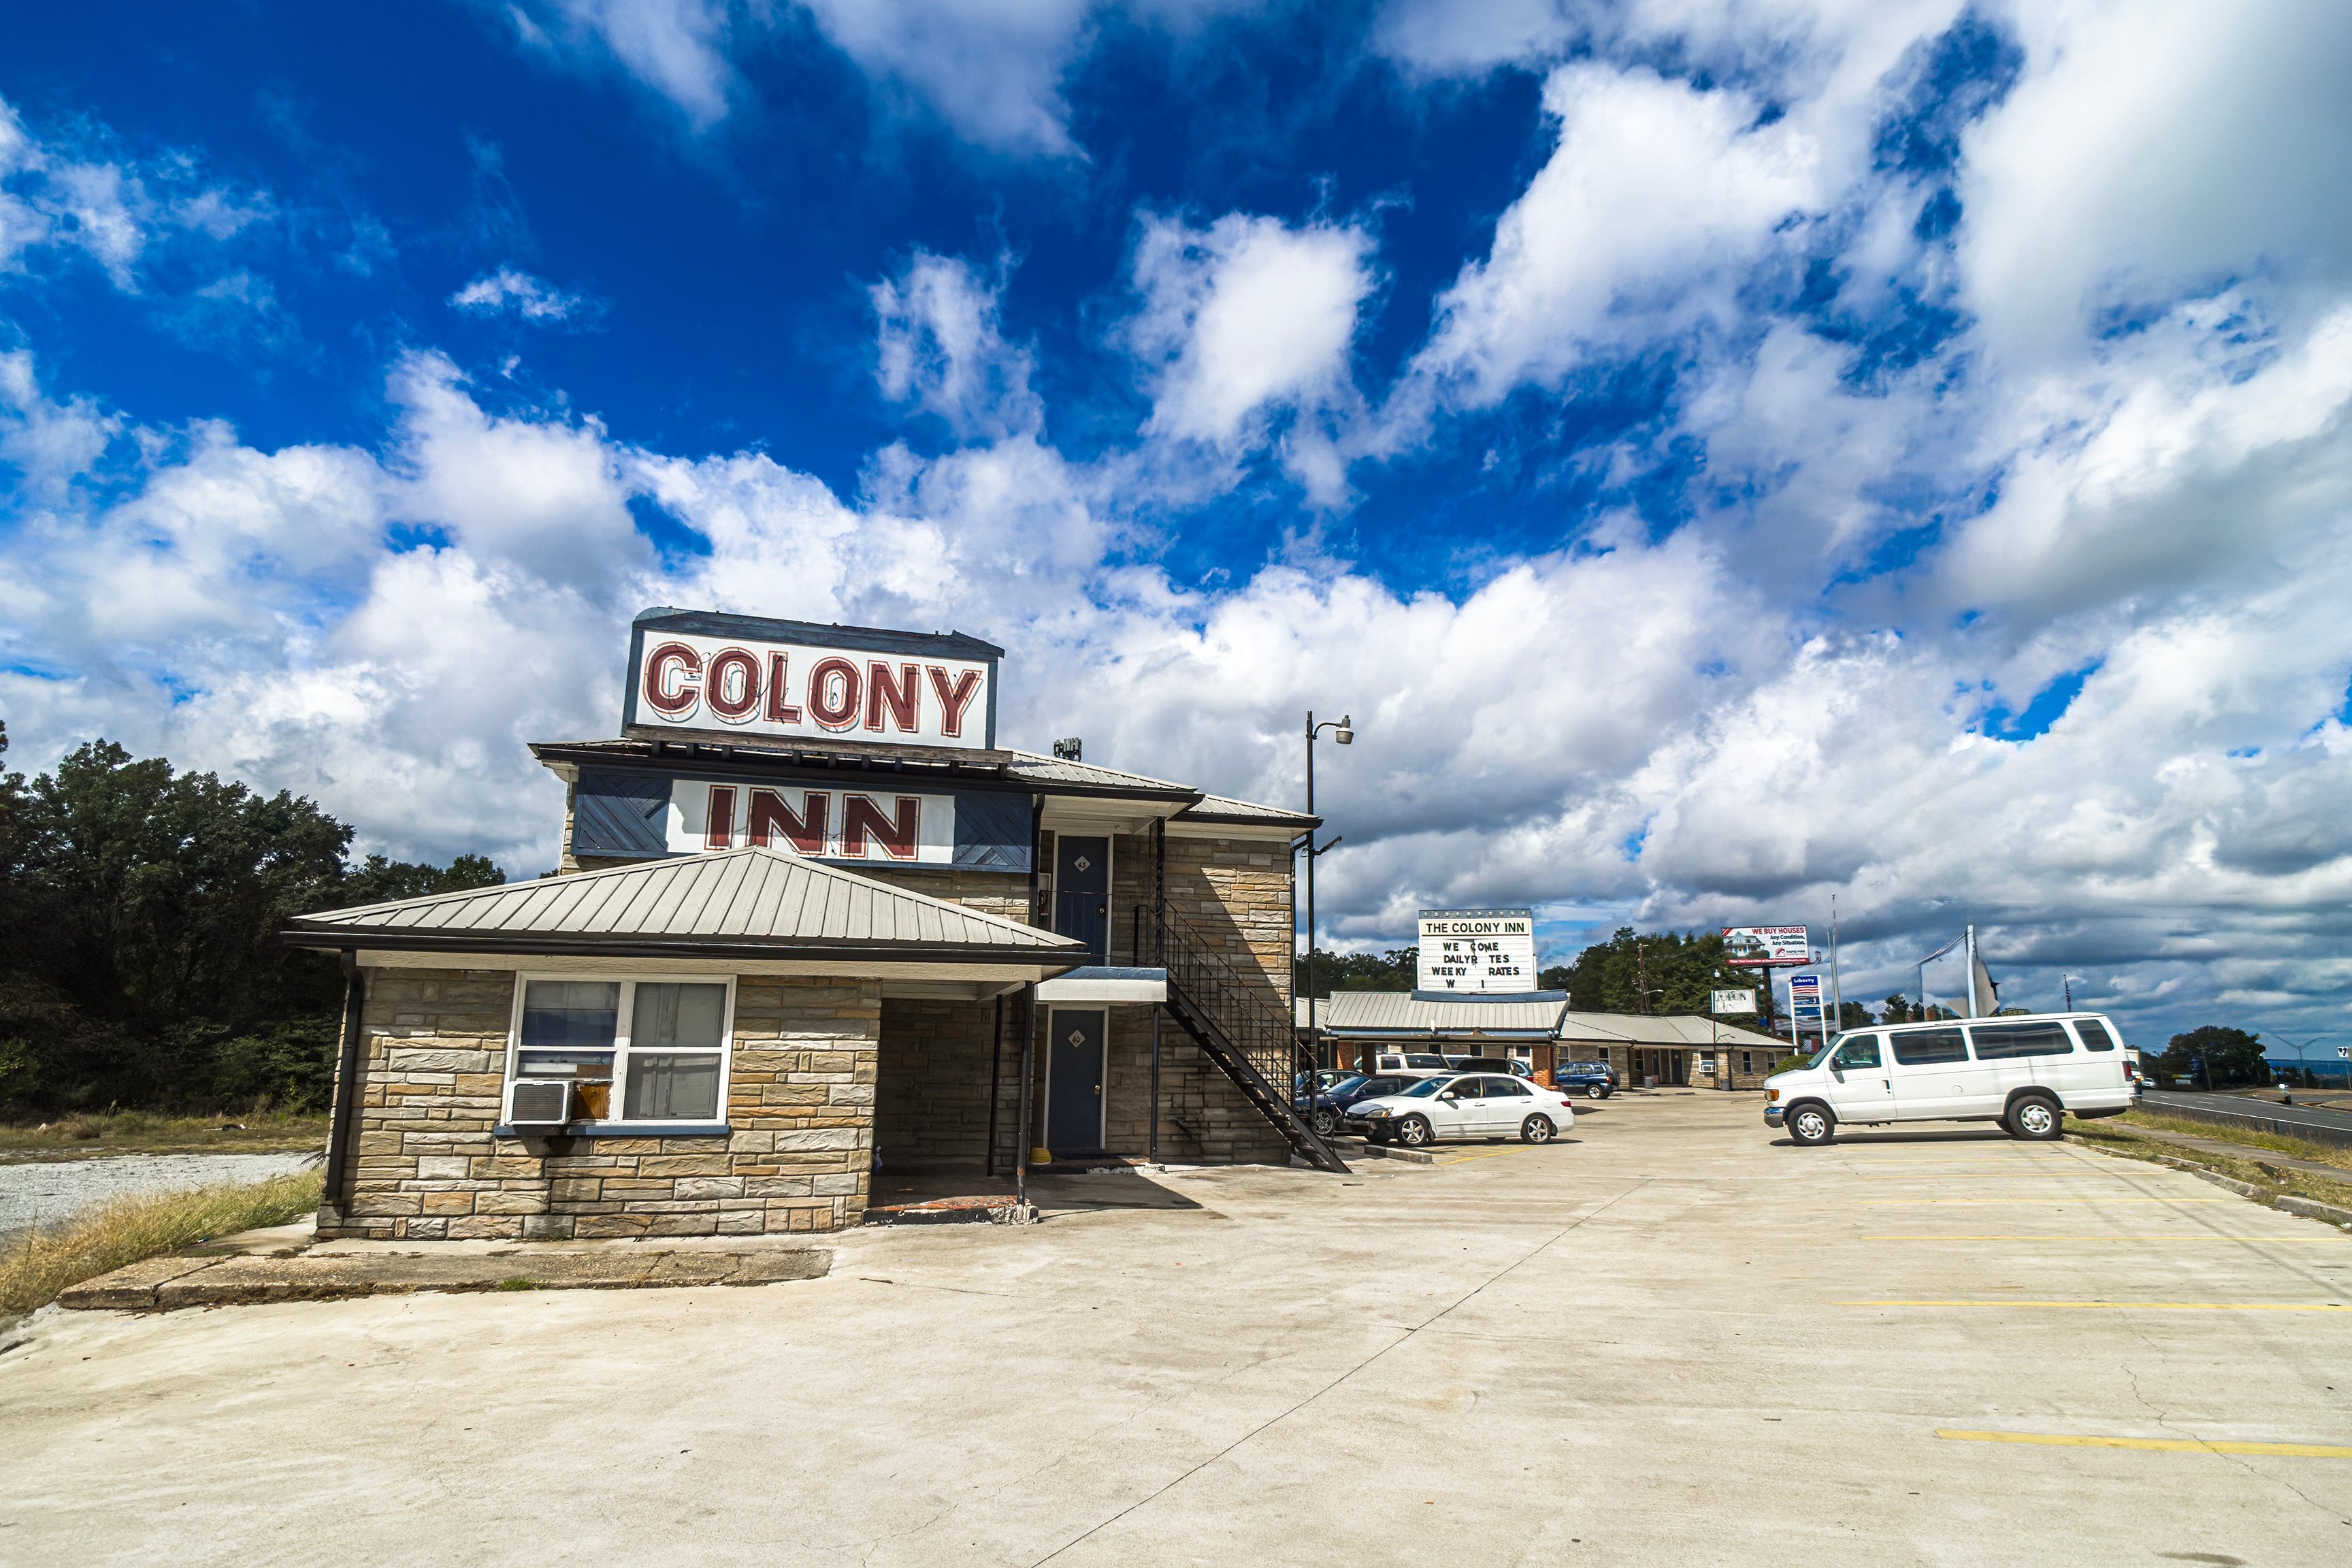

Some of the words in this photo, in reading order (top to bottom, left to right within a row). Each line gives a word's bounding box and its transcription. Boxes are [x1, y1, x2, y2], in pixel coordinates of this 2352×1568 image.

[642, 641, 982, 738] COLONY
[704, 784, 921, 861] INN
[1426, 923, 1448, 933] THE
[1452, 923, 1500, 933] COLONY
[1505, 922, 1524, 932] INN
[1488, 967, 1520, 976] RATES
